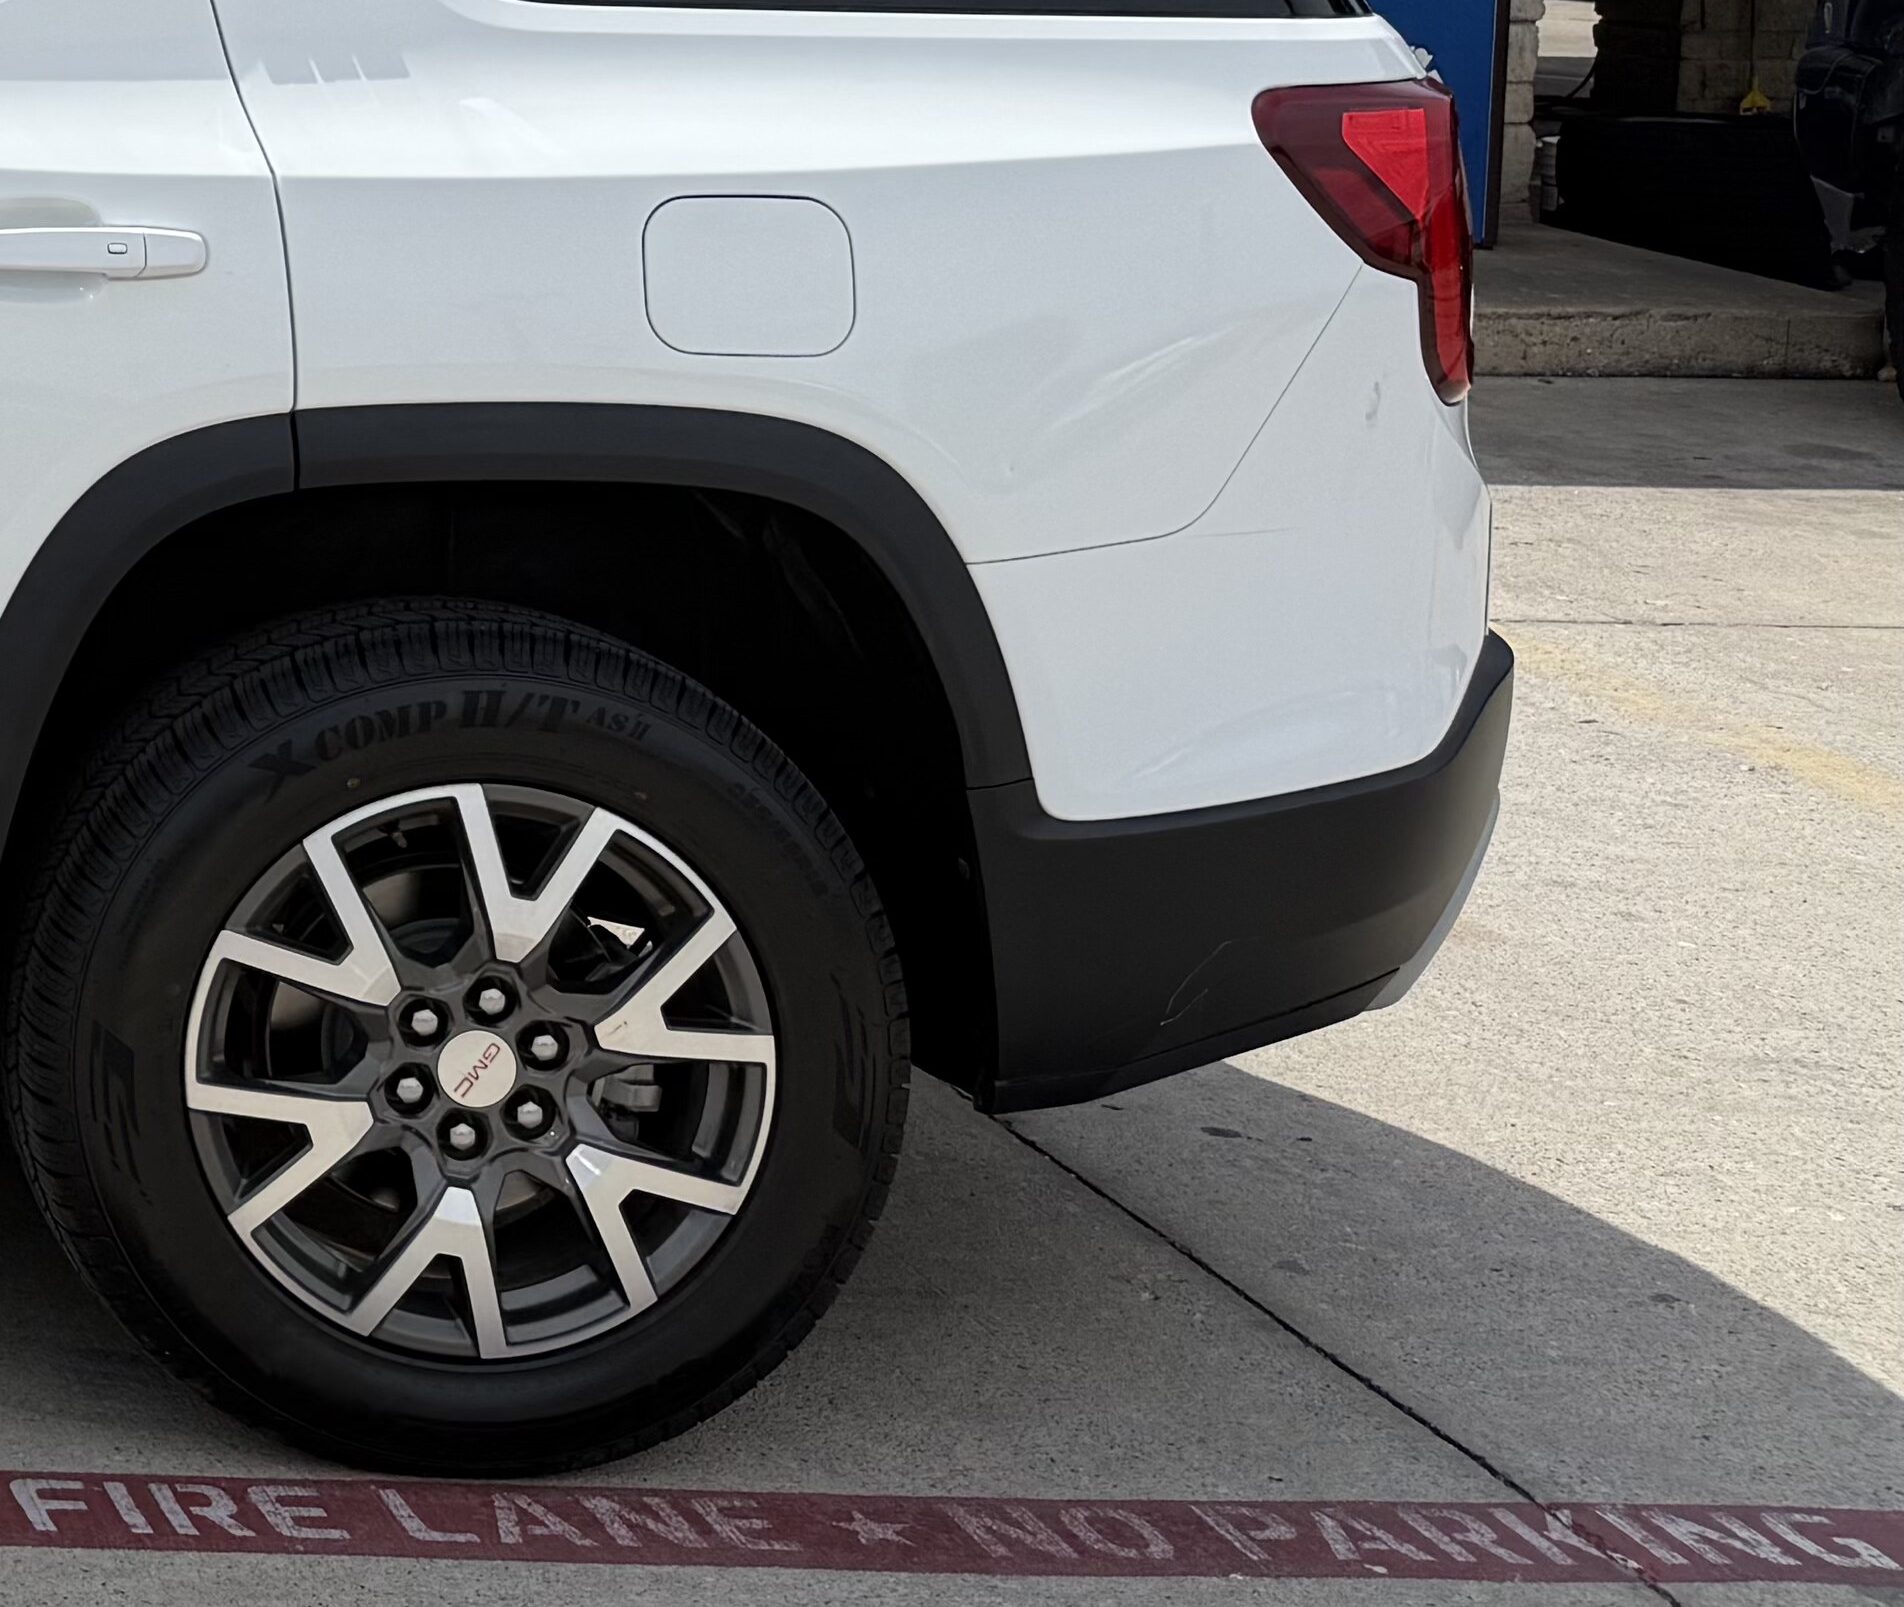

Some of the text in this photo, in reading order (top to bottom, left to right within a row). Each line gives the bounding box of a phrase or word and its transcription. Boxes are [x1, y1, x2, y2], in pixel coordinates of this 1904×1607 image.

[457, 688, 582, 732] H/T
[453, 1042, 501, 1099] GMC
[8, 1478, 1904, 1572] FIRE LANE NO PARKING
